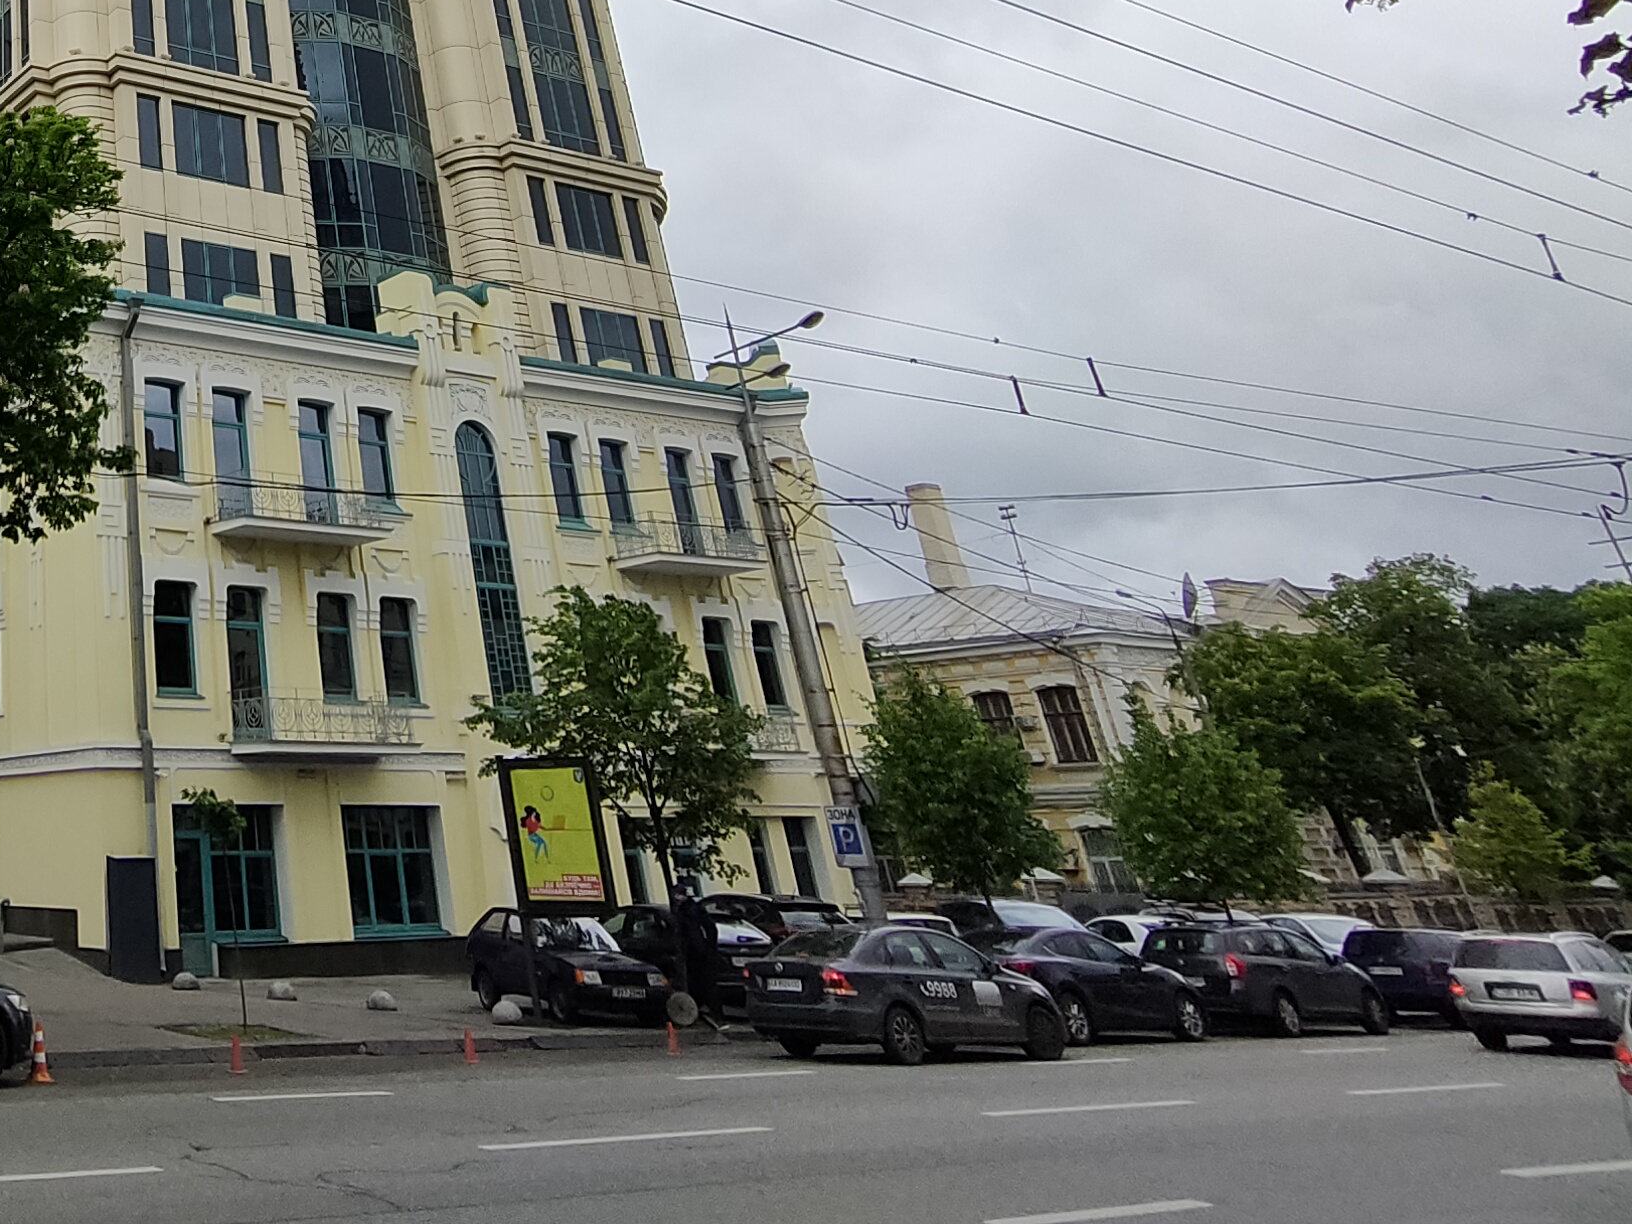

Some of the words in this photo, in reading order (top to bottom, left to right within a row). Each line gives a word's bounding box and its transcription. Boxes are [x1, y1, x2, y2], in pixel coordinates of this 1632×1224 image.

[827, 809, 856, 820] ЗОНА
[838, 826, 854, 852] P
[926, 980, 957, 998] 9988
